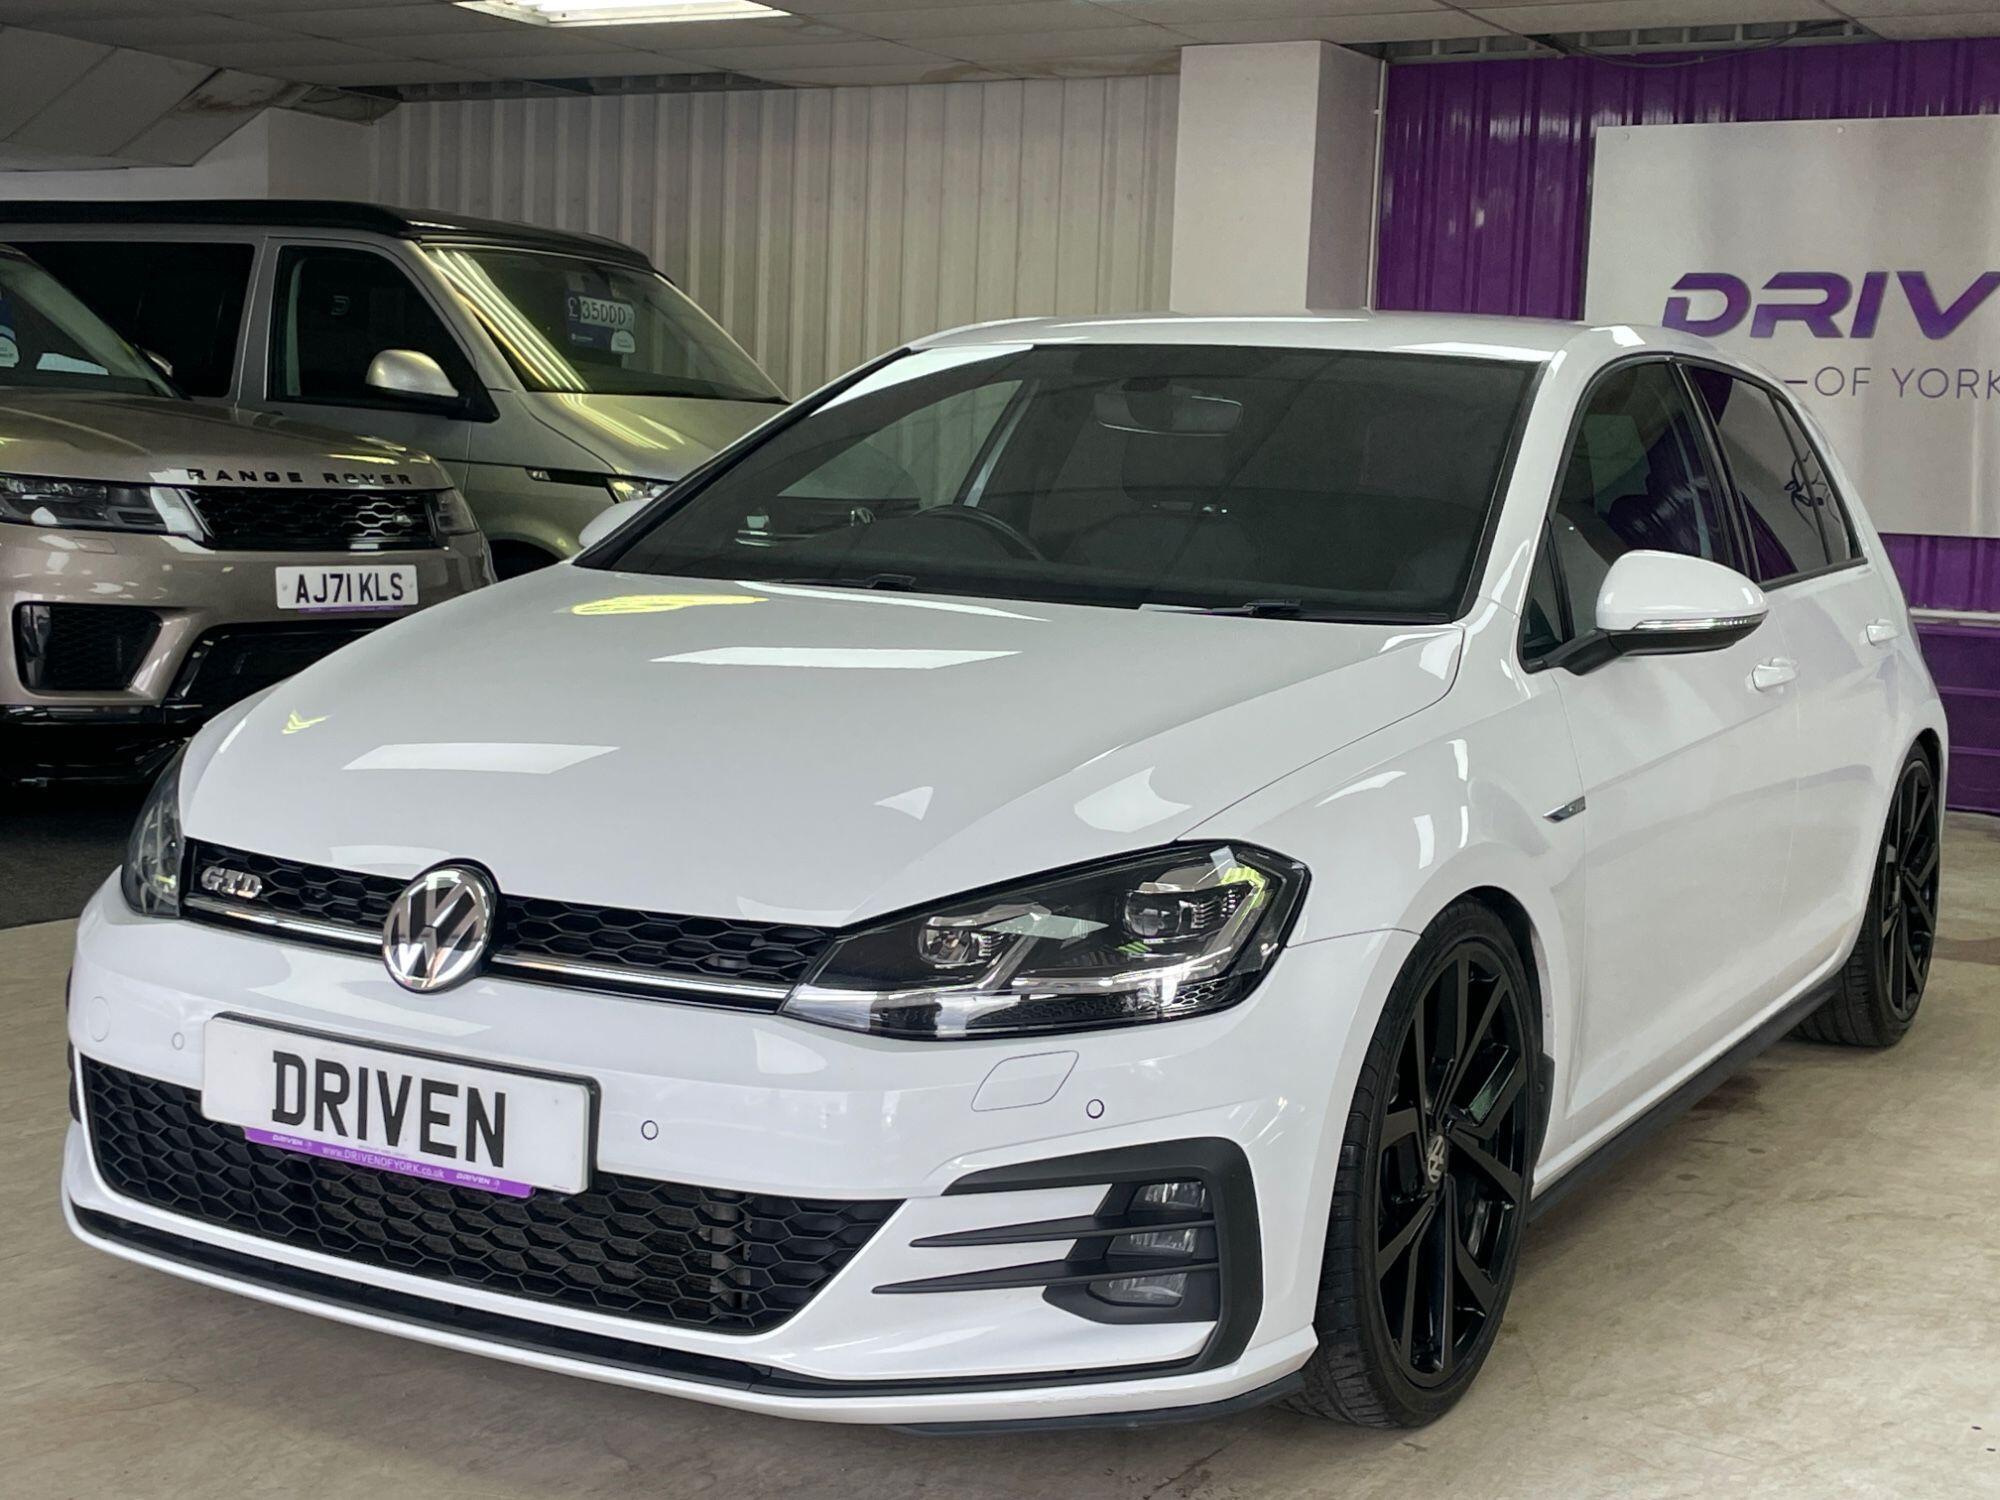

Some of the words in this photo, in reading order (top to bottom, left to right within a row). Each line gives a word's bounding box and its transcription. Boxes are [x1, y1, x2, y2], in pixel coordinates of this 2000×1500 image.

[1814, 366, 1871, 397] OF
[186, 468, 303, 484] RANGE
[322, 472, 412, 486] ROVER
[359, 572, 404, 602] KLS
[271, 1050, 507, 1169] DRIVEN
[321, 1146, 446, 1179] www.DRIVENOFYORK.co.uk
